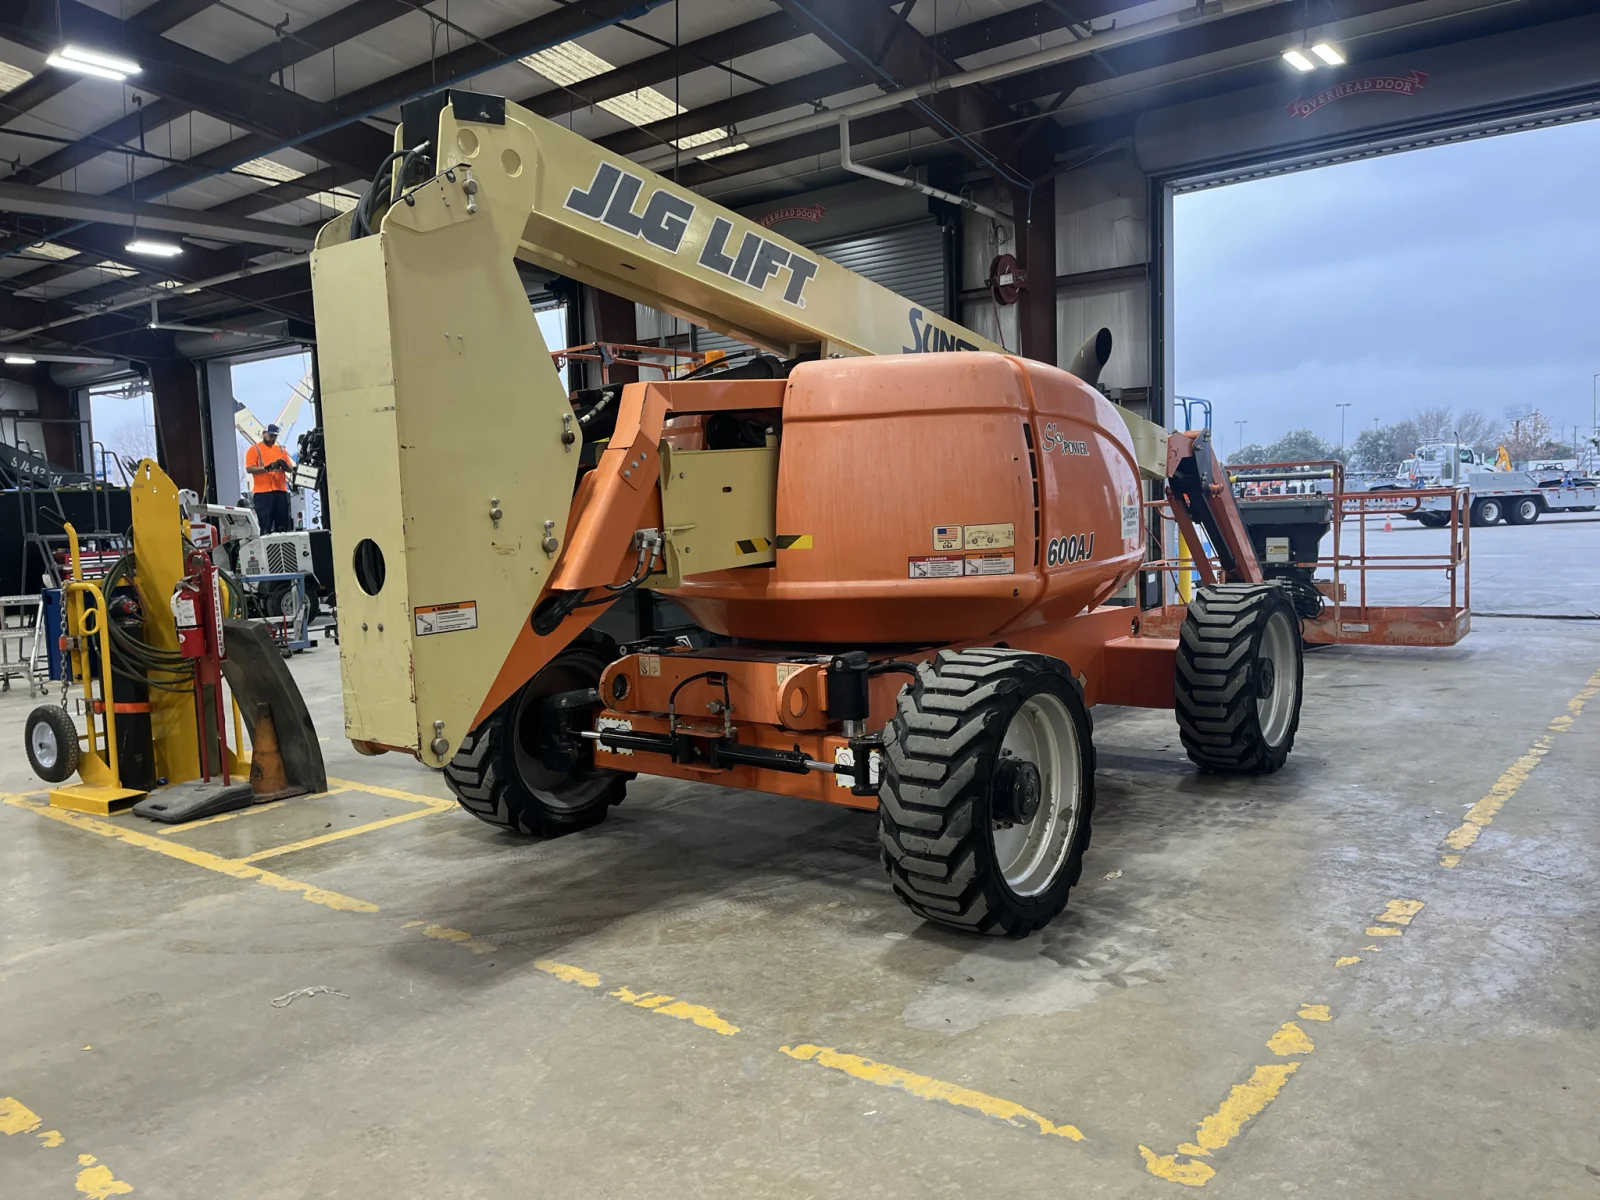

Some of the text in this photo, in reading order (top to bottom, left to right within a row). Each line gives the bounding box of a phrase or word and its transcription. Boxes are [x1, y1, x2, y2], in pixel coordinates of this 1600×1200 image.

[1301, 79, 1412, 114] OVERHEAD DOOR
[563, 160, 819, 308] JLG LIFT
[761, 209, 818, 227] VERHEAD DOOR
[1047, 532, 1095, 567] 600AJ
[215, 600, 224, 653] EQUIPMENT
